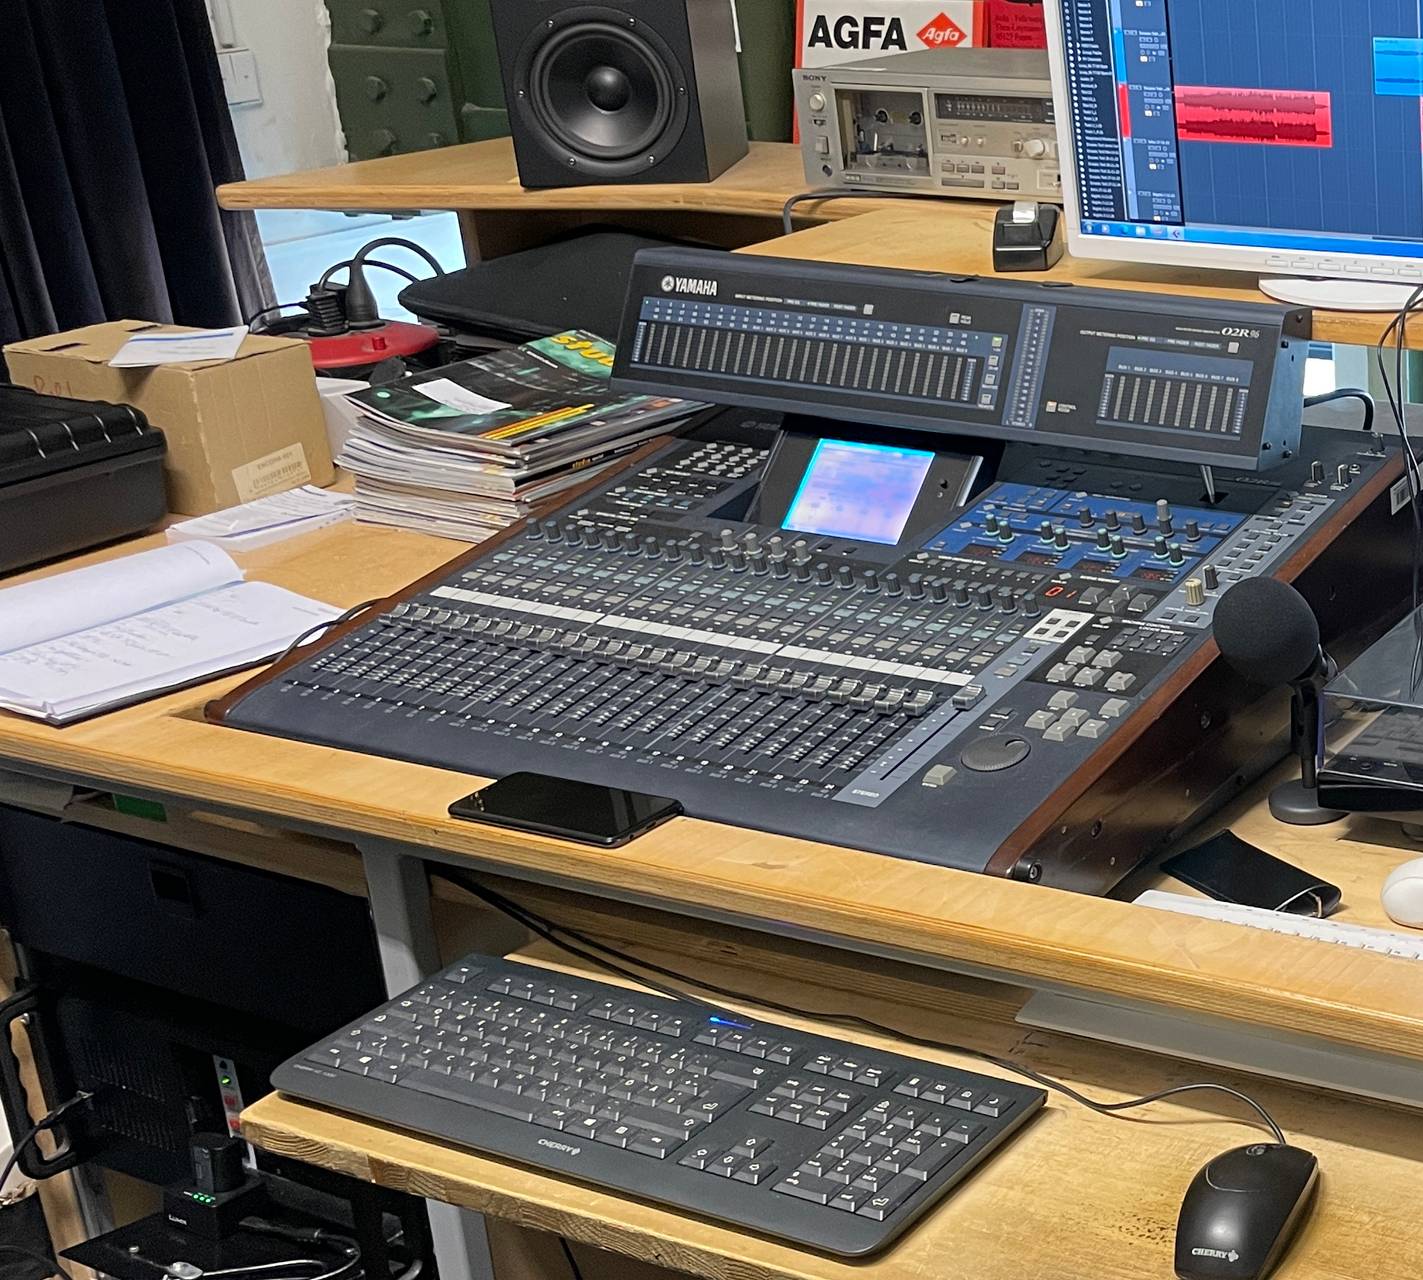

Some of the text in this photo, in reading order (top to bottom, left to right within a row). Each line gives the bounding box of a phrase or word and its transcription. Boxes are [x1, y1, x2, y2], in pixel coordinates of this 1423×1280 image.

[808, 15, 907, 50] AGFA
[923, 26, 960, 44] Agfa
[675, 277, 718, 297] YAMAHA
[537, 1138, 574, 1153] CHERRY
[1191, 1247, 1229, 1260] CHERRY
